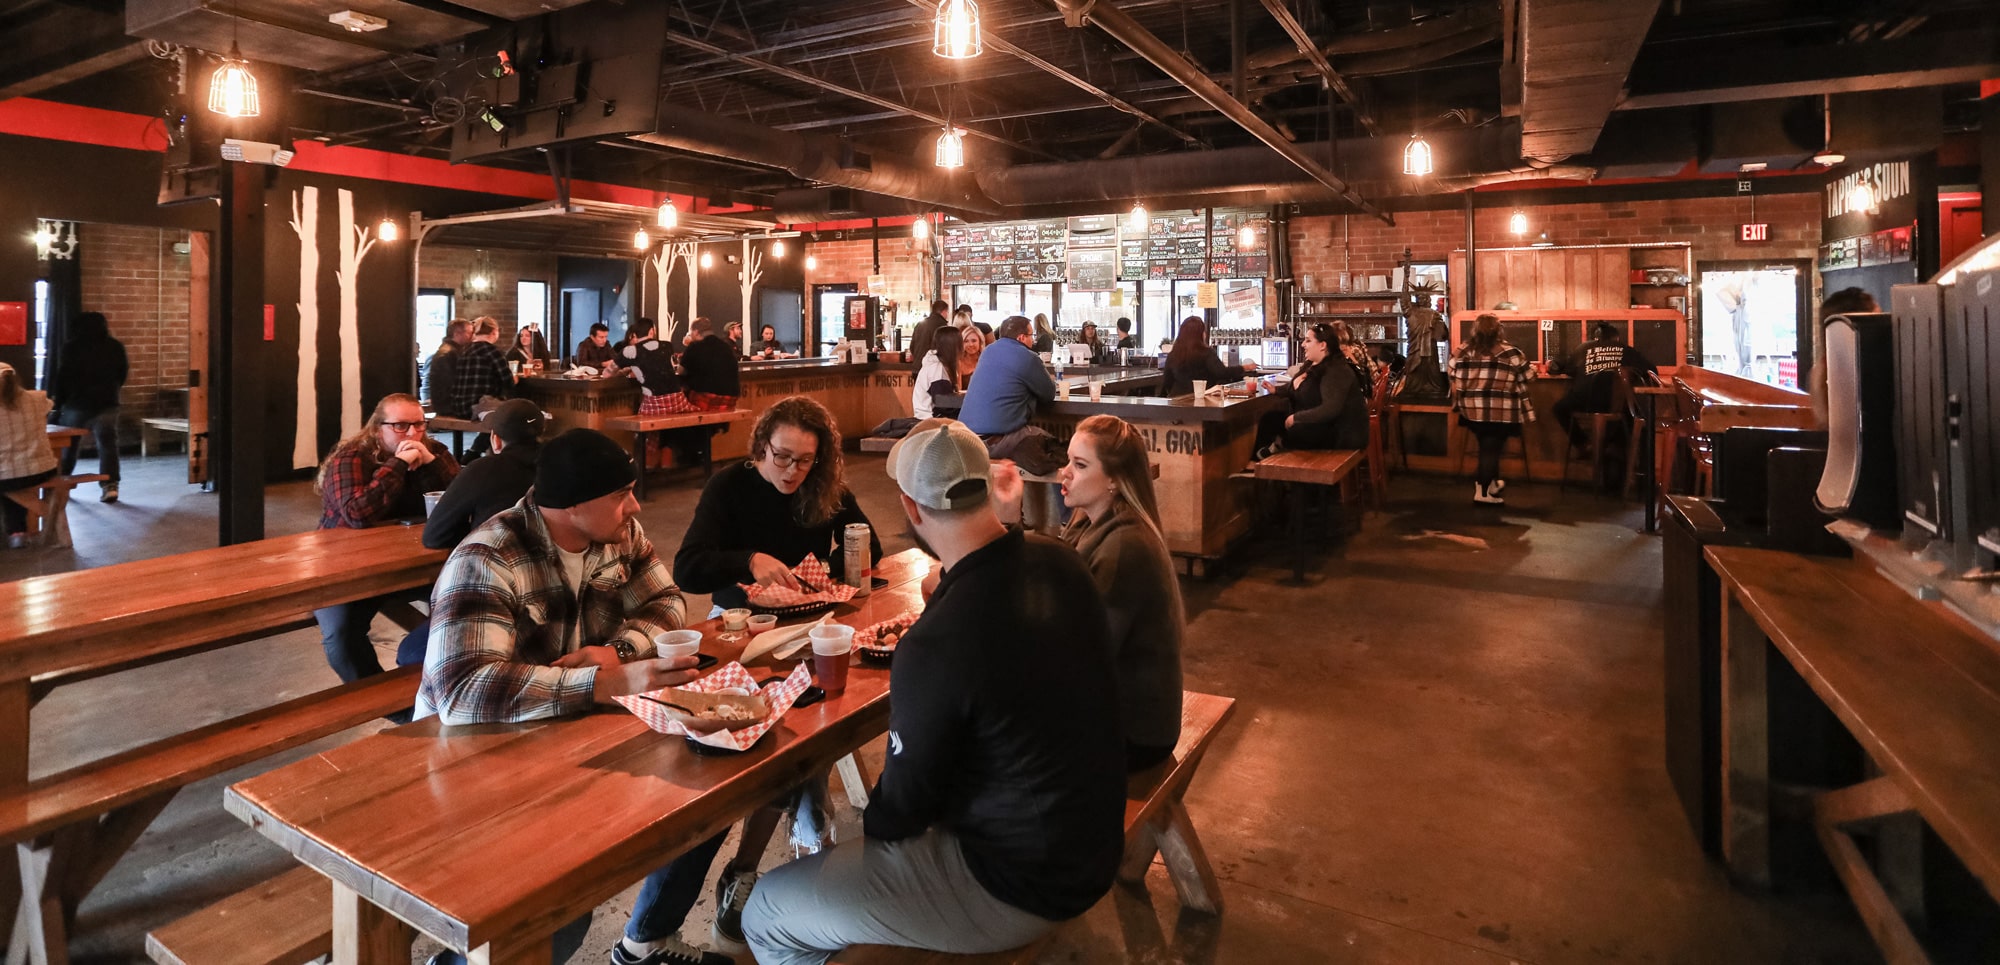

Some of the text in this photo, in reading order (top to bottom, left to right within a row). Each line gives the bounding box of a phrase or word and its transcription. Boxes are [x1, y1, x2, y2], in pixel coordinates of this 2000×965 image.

[1742, 223, 1768, 241] EXIT
[1585, 362, 1622, 374] Possible
[875, 375, 903, 388] PROST
[1166, 429, 1203, 456] GRA
